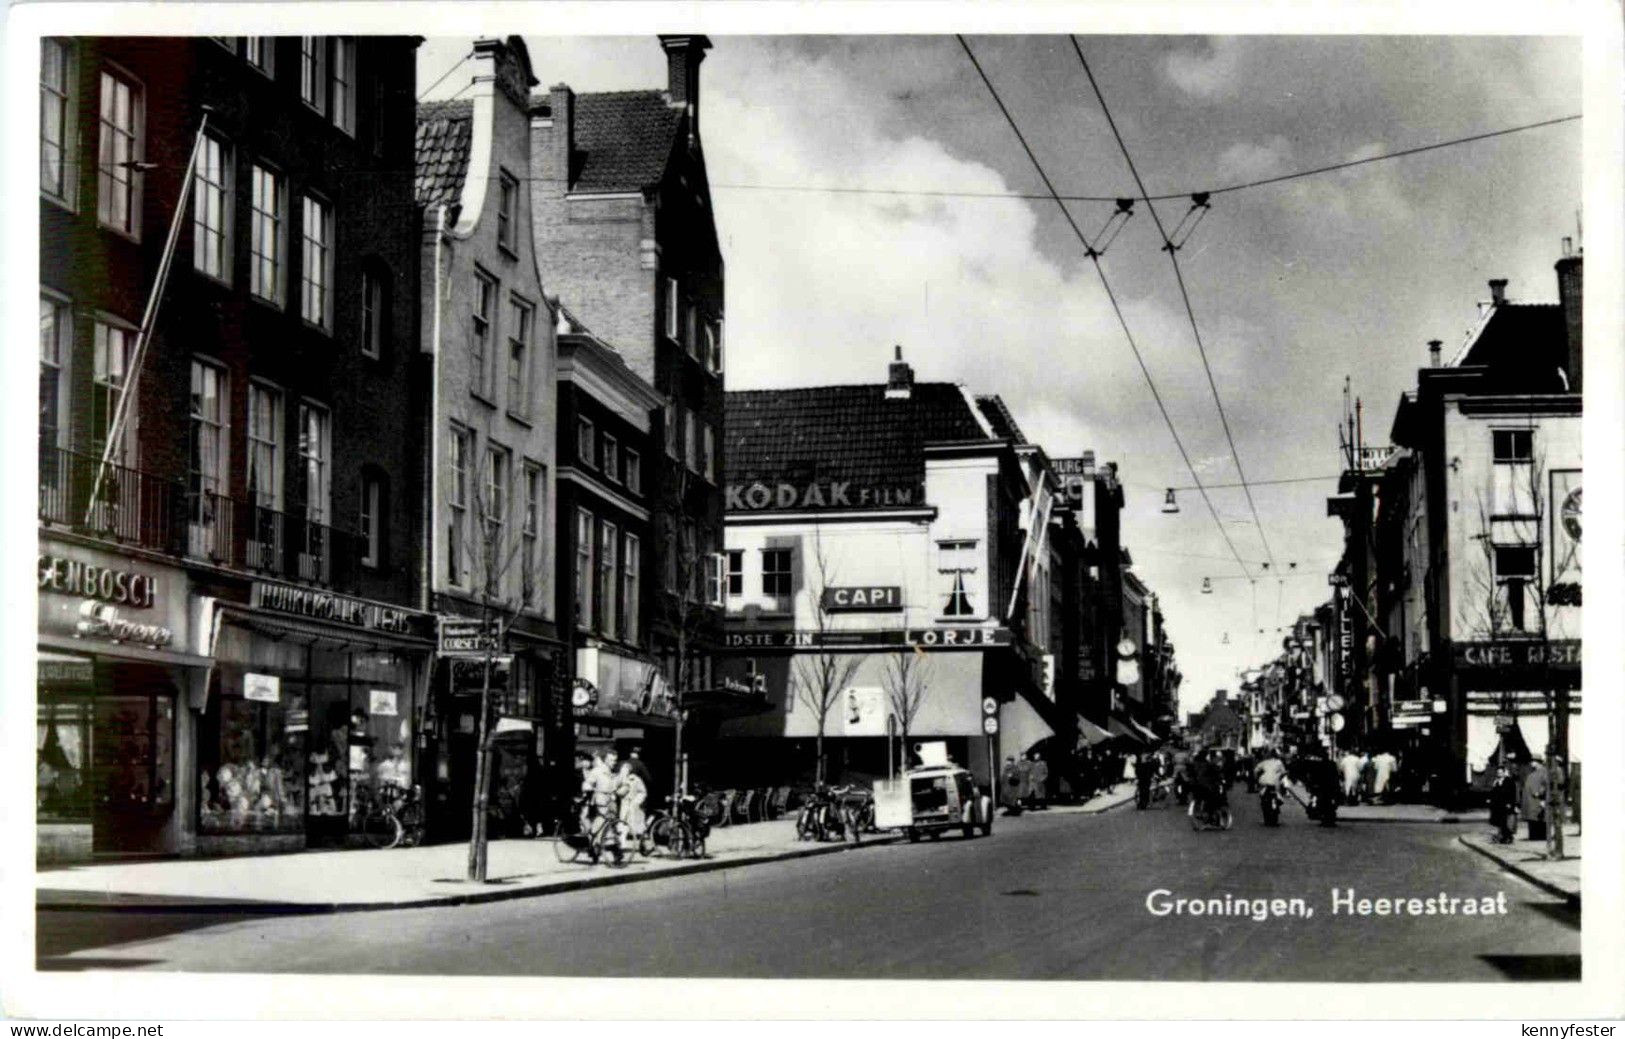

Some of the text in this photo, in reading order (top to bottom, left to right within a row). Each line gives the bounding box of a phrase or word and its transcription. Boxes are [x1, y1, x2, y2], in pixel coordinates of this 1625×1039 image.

[725, 481, 912, 510] KODAK FILM
[834, 588, 893, 605] CAPI
[905, 628, 996, 646] LORJE
[1465, 646, 1513, 665] CAFE
